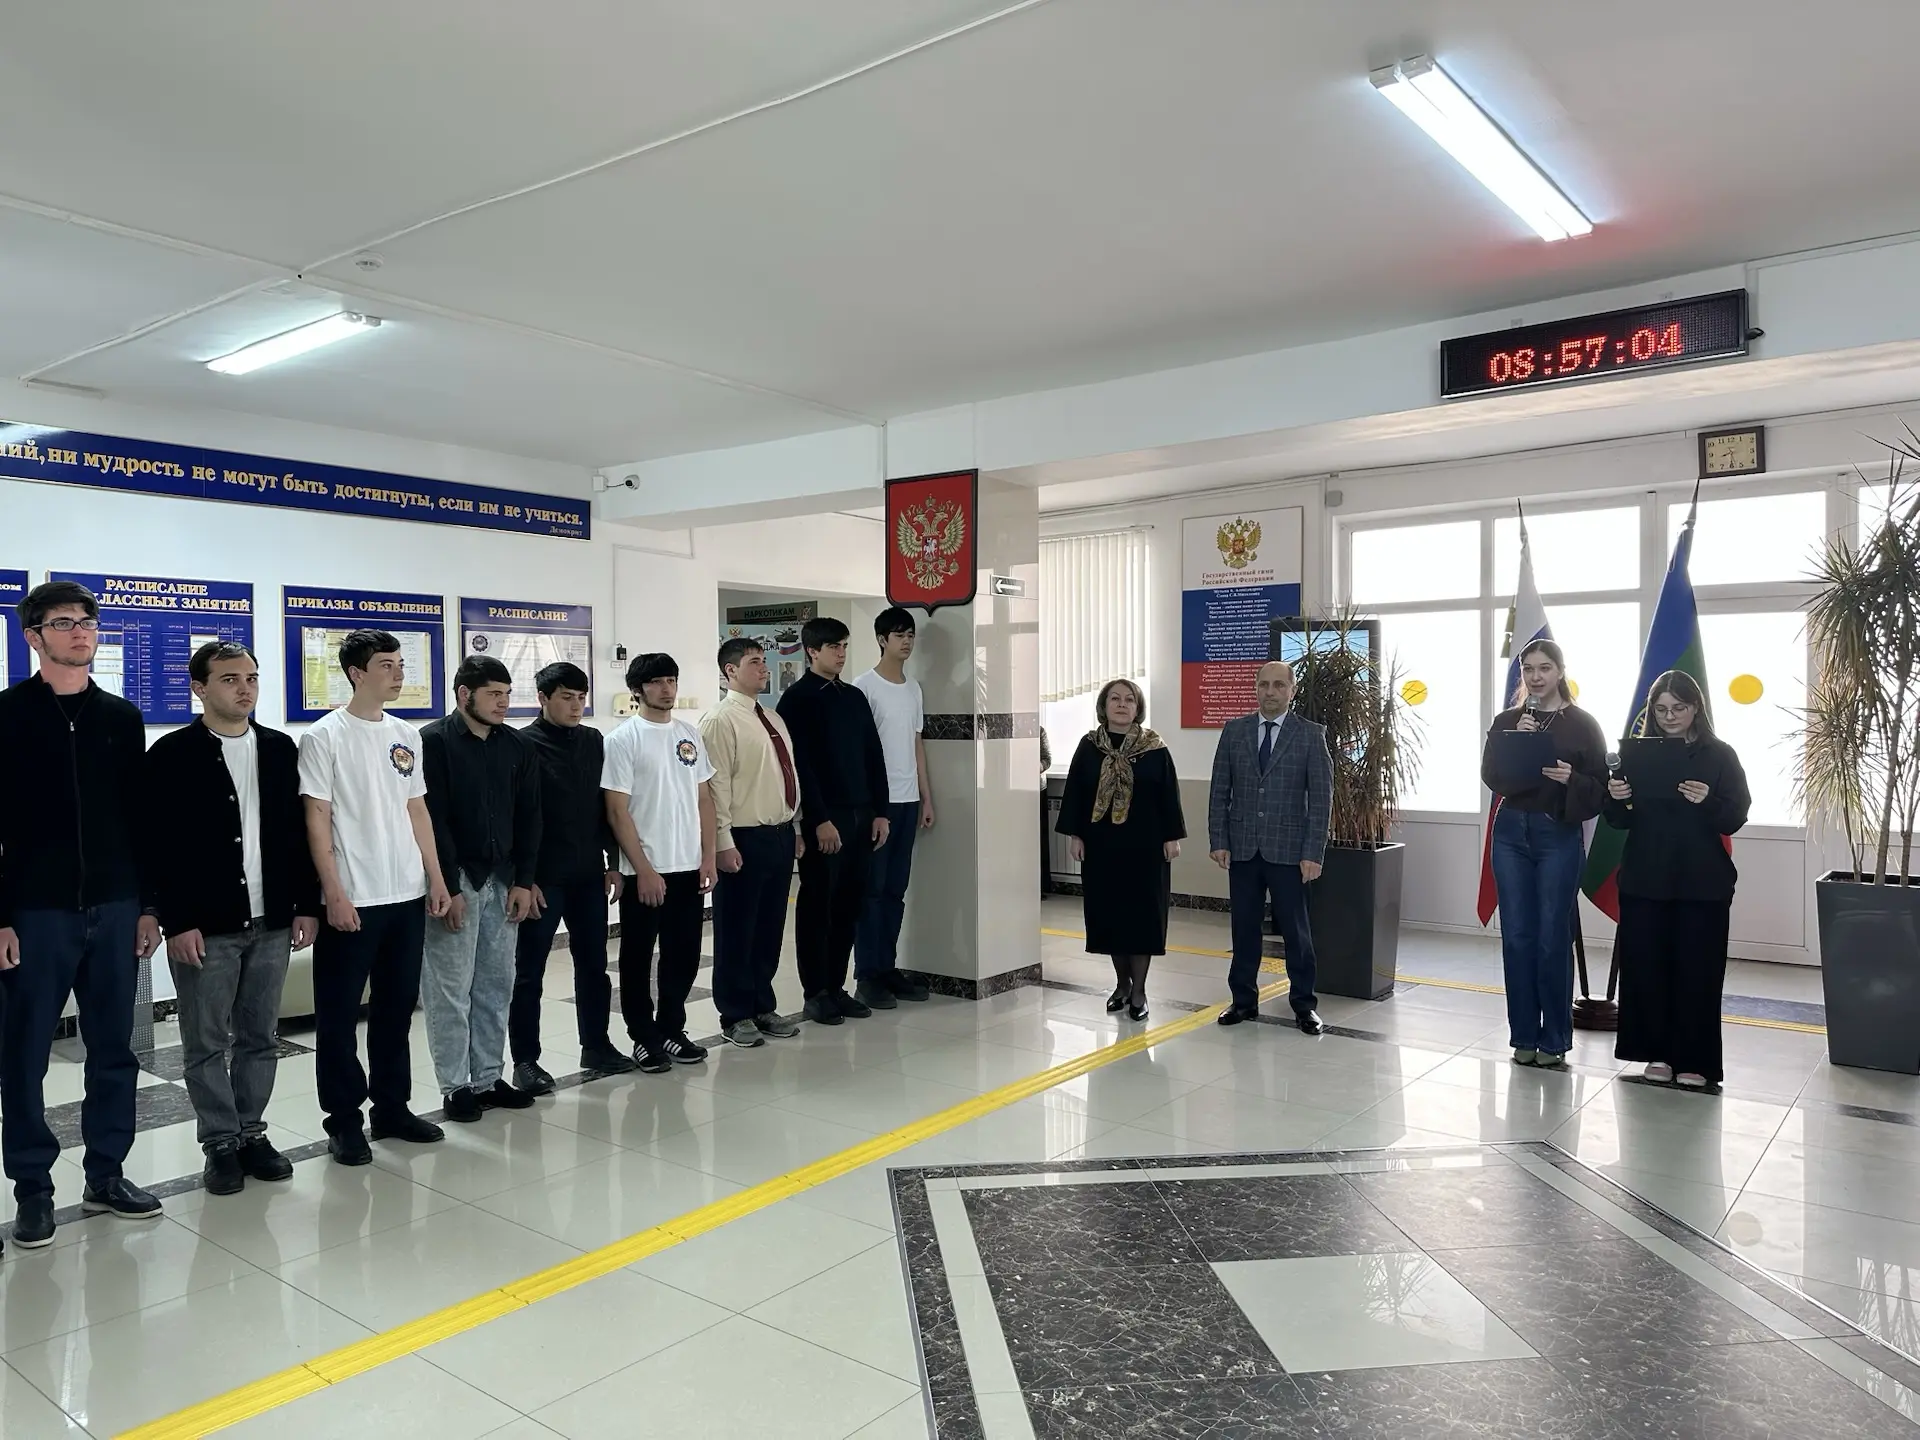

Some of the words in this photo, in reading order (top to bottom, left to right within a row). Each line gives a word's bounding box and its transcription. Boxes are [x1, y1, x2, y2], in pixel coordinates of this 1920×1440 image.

[1488, 322, 1682, 383] 08:57:04
[84, 450, 185, 476] мудрость
[192, 465, 216, 481] не
[223, 469, 278, 492] могут
[283, 474, 328, 495] быть
[334, 483, 435, 510] достигнуты,
[439, 497, 473, 513] если
[478, 501, 499, 516] им
[503, 505, 521, 518] не
[524, 507, 583, 526] учиться.
[105, 579, 208, 596] РАСПИСАНИЕ
[181, 598, 250, 611] ЗАНЯТИЙ
[287, 596, 354, 610] ПРИКАЗЫ
[358, 600, 442, 615] ОБЪЯВЛЕНИЯ
[744, 607, 795, 619] НАРКОТИКАМ
[488, 607, 569, 621] РАСПИСАНИЕ
